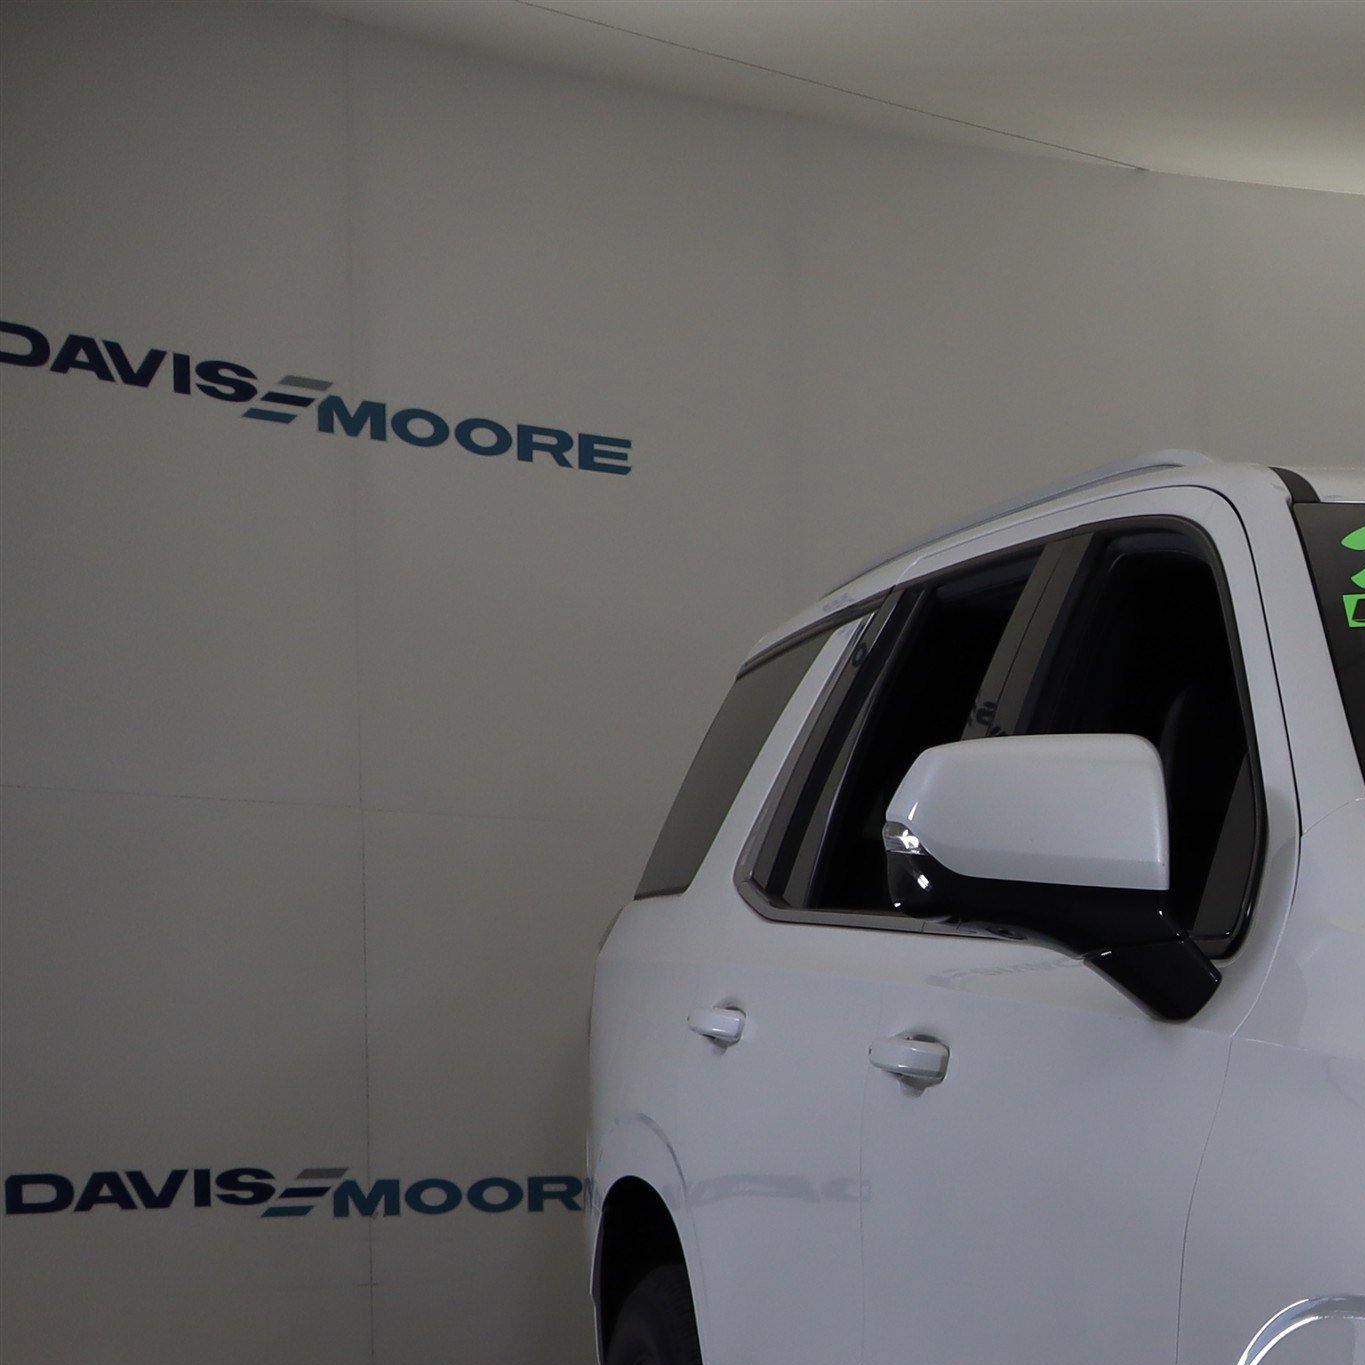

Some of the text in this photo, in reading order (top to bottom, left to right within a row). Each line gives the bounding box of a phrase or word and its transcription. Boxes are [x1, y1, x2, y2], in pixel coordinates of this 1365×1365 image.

[0, 322, 631, 475] DAVIS MOORE
[5, 1168, 583, 1217] DAVIS MOOR
